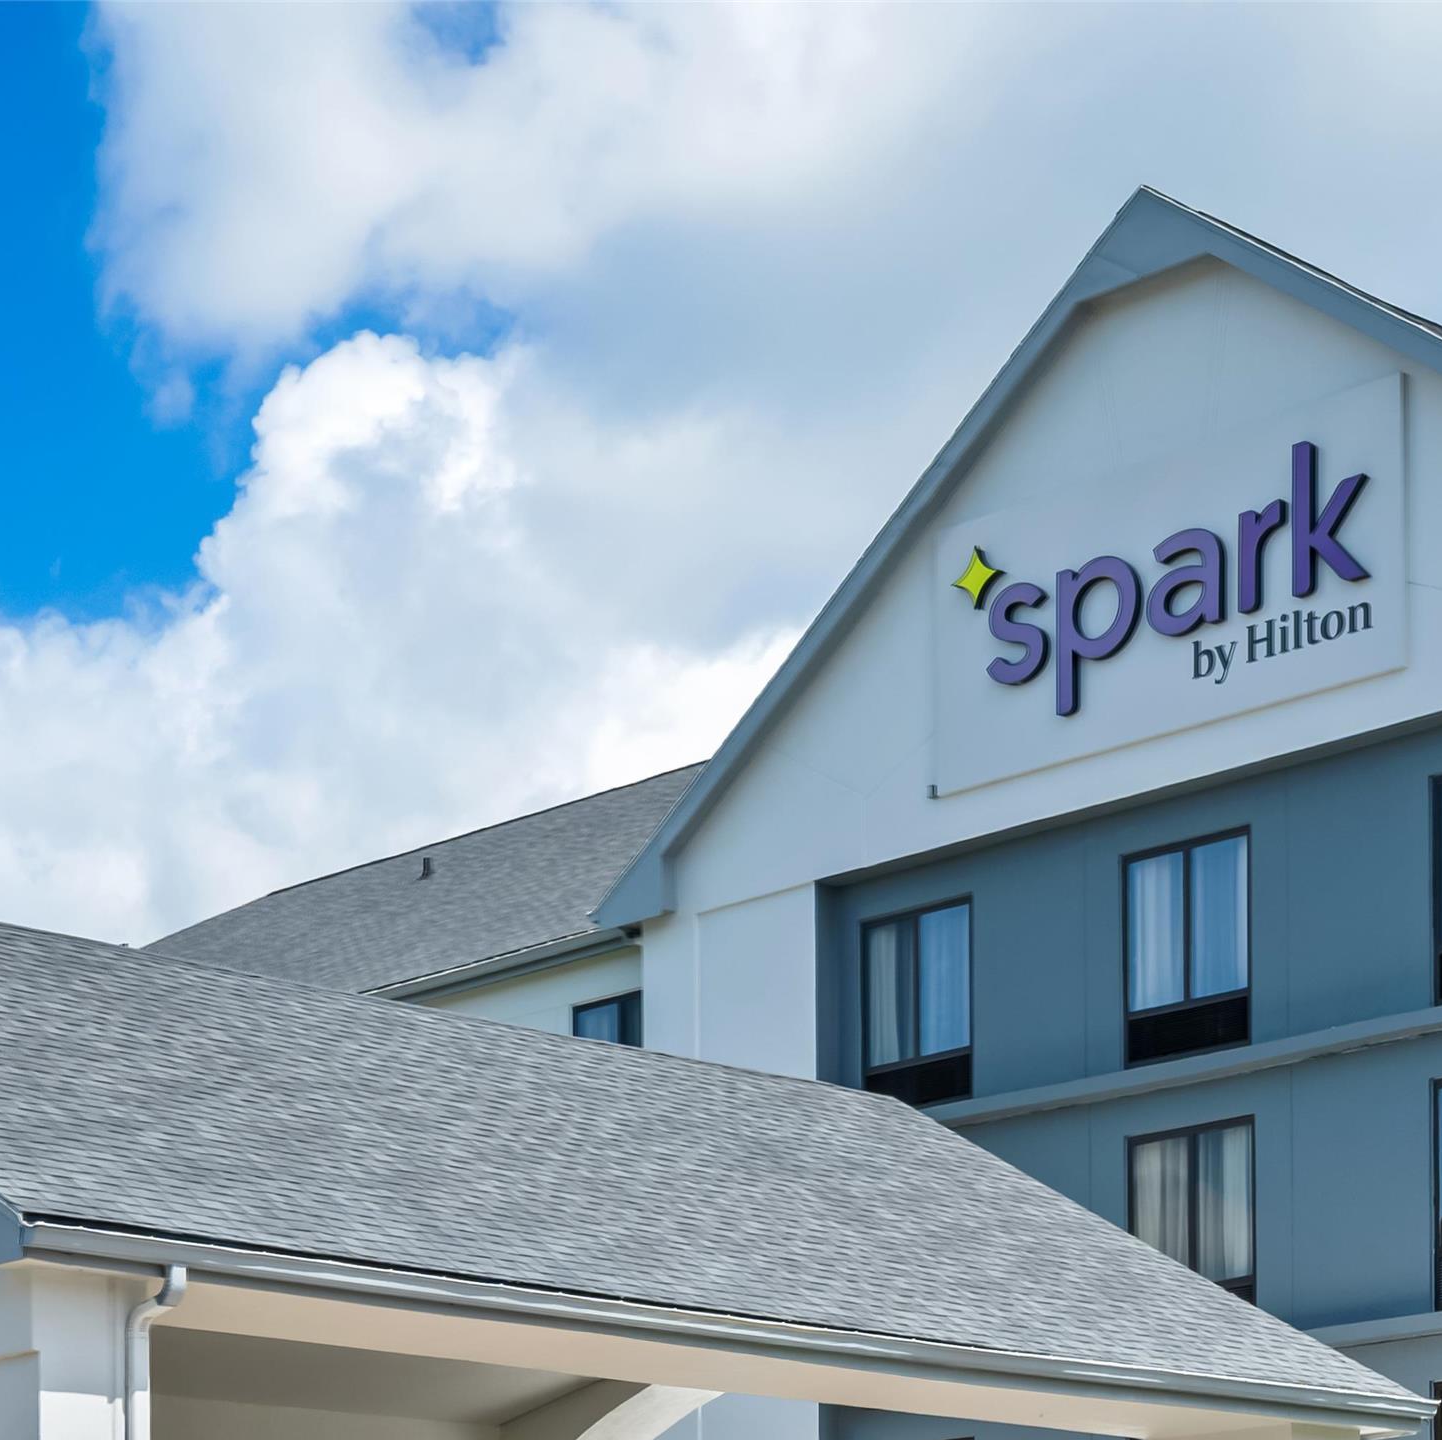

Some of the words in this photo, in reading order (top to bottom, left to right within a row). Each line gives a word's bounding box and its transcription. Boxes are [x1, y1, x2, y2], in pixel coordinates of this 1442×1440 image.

[986, 440, 1373, 718] spark
[1192, 640, 1238, 684] by
[1245, 601, 1374, 664] Hilton
